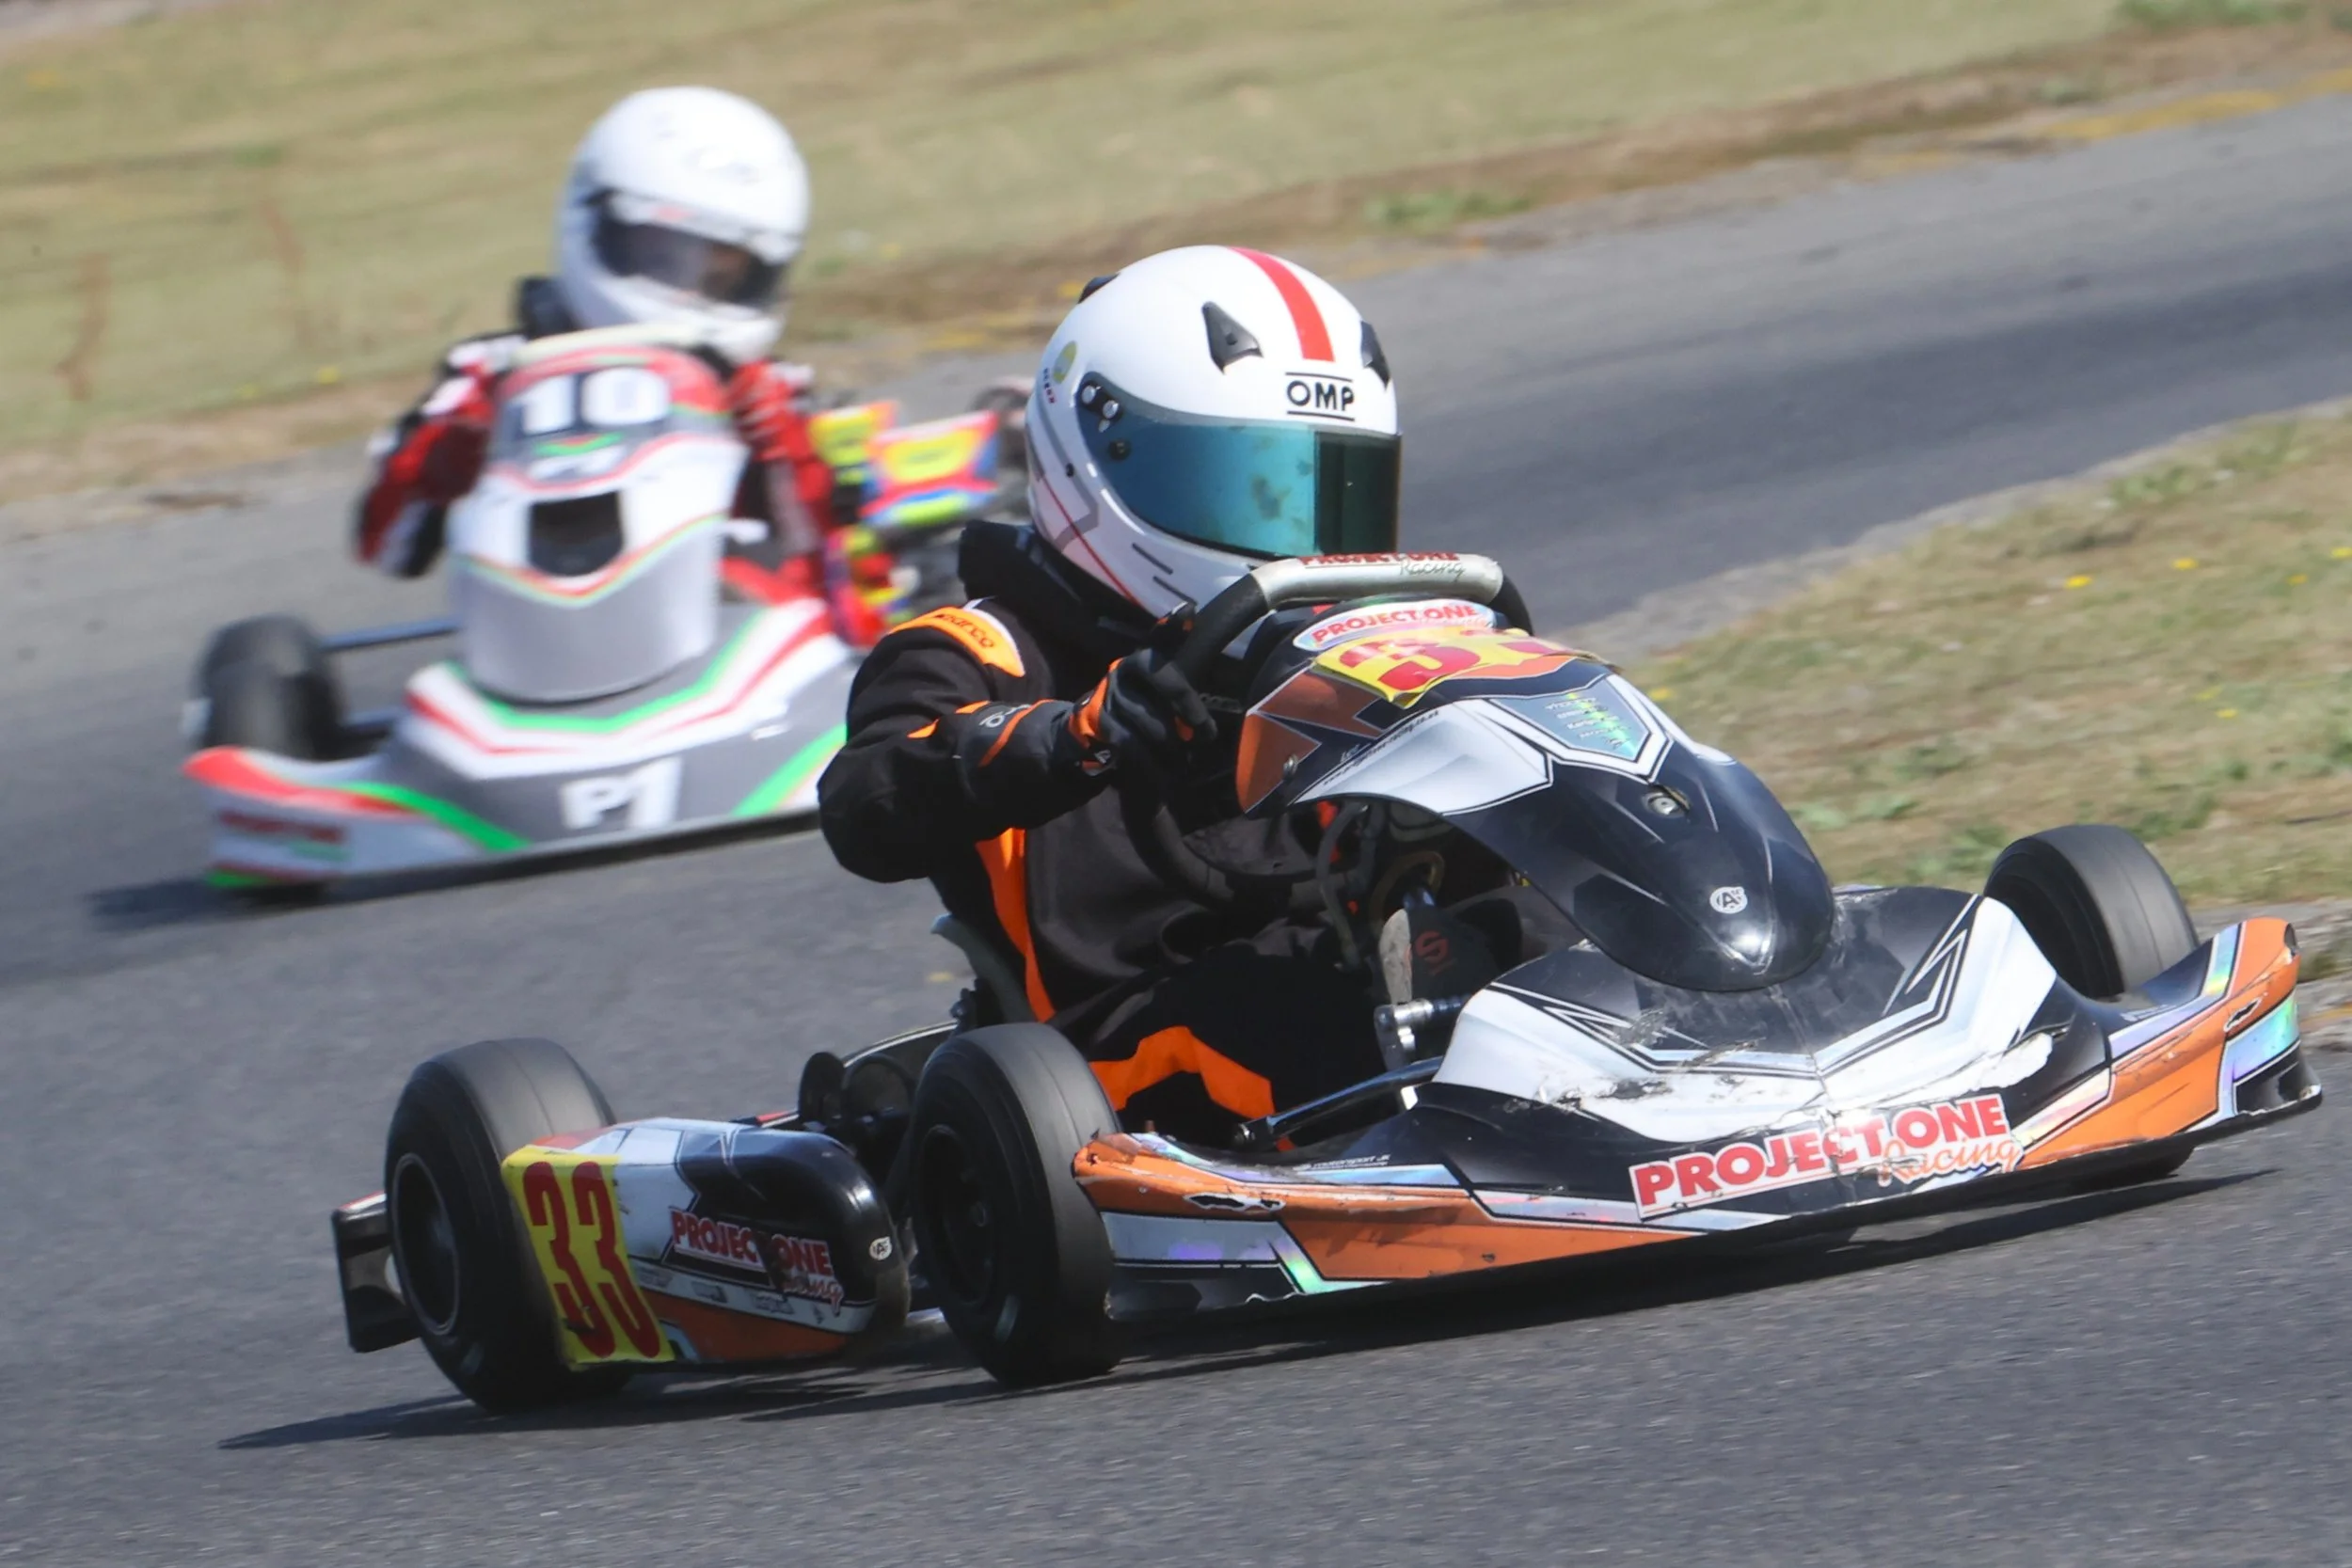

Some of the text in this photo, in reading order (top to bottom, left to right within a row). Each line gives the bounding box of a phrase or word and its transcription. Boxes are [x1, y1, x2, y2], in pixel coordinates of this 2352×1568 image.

[518, 367, 671, 435] 10
[1286, 380, 1354, 411] OMP
[1312, 610, 1418, 643] PROJECT
[1422, 605, 1478, 621] ONE
[562, 757, 684, 830] P1
[1634, 1097, 2007, 1207] PROJECT ONE
[1881, 1136, 2019, 1187] Racing
[523, 1162, 660, 1357] 33
[771, 1236, 834, 1276] ONE
